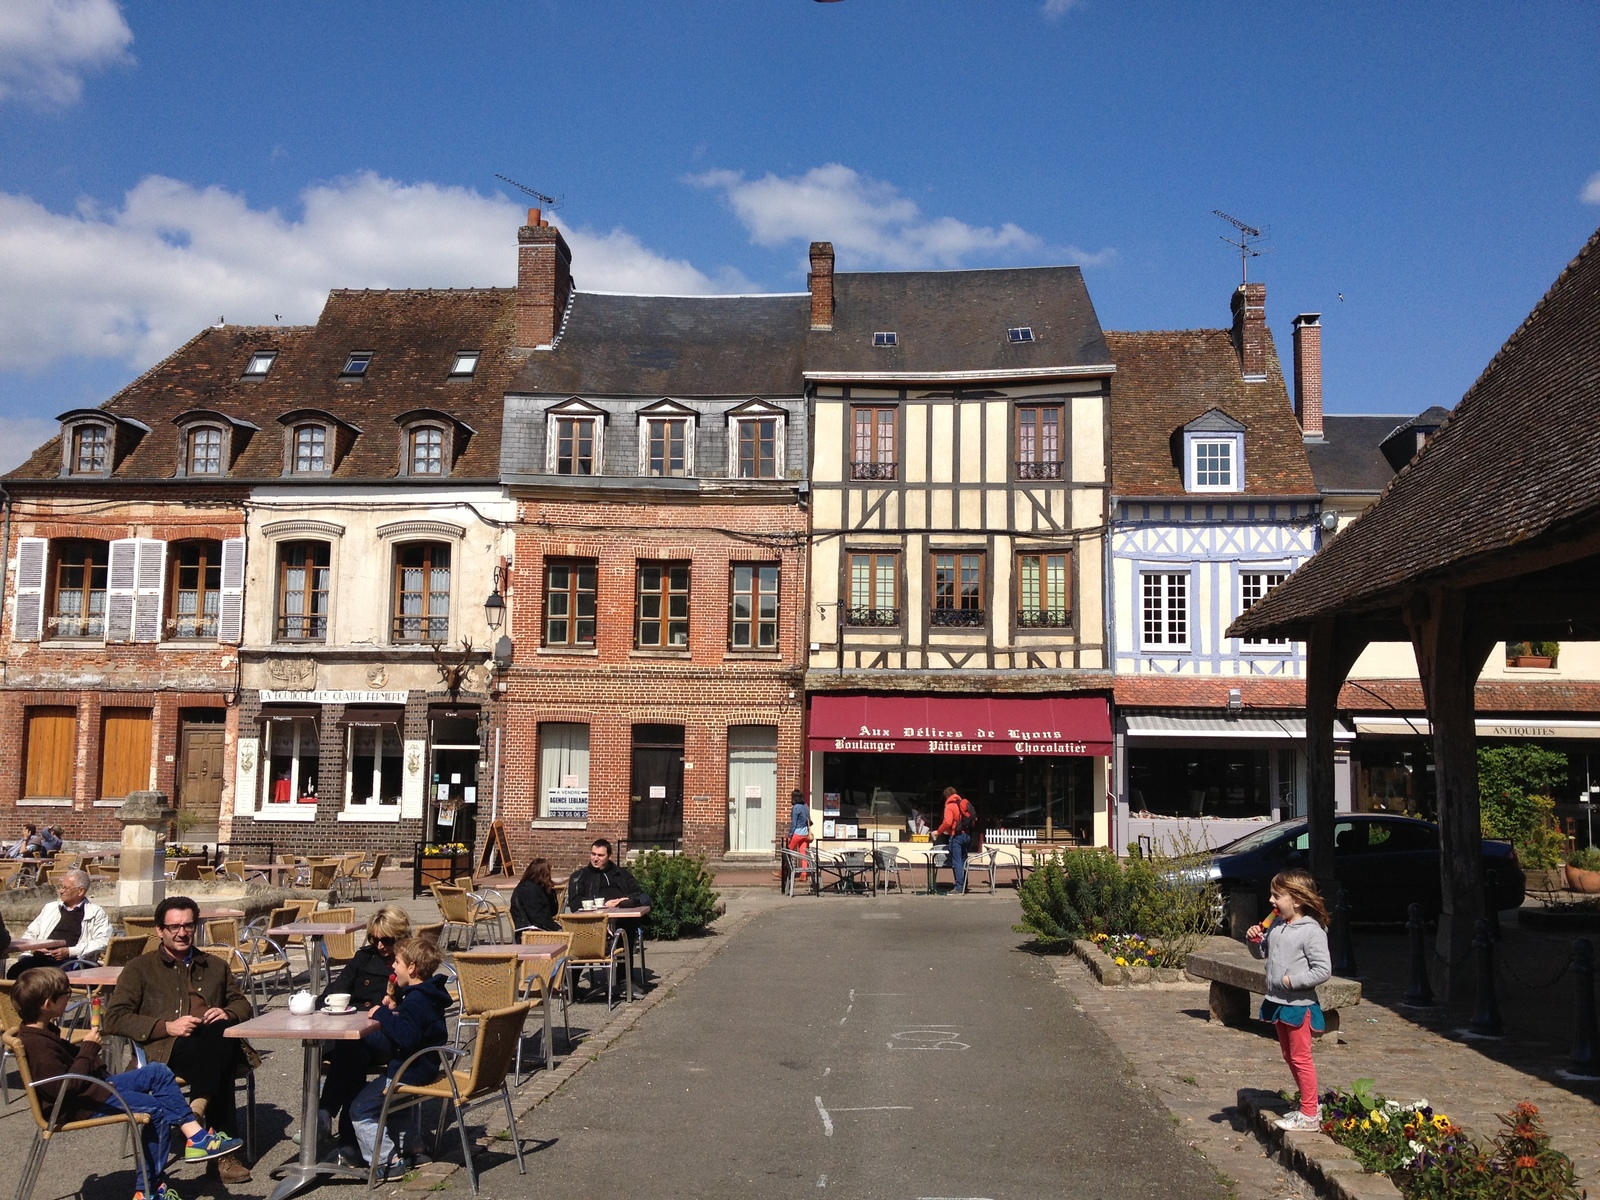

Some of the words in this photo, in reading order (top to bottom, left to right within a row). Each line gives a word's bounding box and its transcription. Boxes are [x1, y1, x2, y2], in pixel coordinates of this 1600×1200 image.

[260, 691, 271, 700] LA
[313, 691, 330, 701] DES
[332, 692, 363, 701] QUATRE
[858, 725, 890, 737] Aux
[903, 727, 963, 738] Délices
[977, 728, 995, 738] de
[1008, 729, 1062, 740] Lyons
[1493, 727, 1555, 736] ANTIQUITES
[835, 739, 896, 753] Boulanger
[928, 740, 983, 753] Pâtissier
[1014, 742, 1087, 754] Chocolatier
